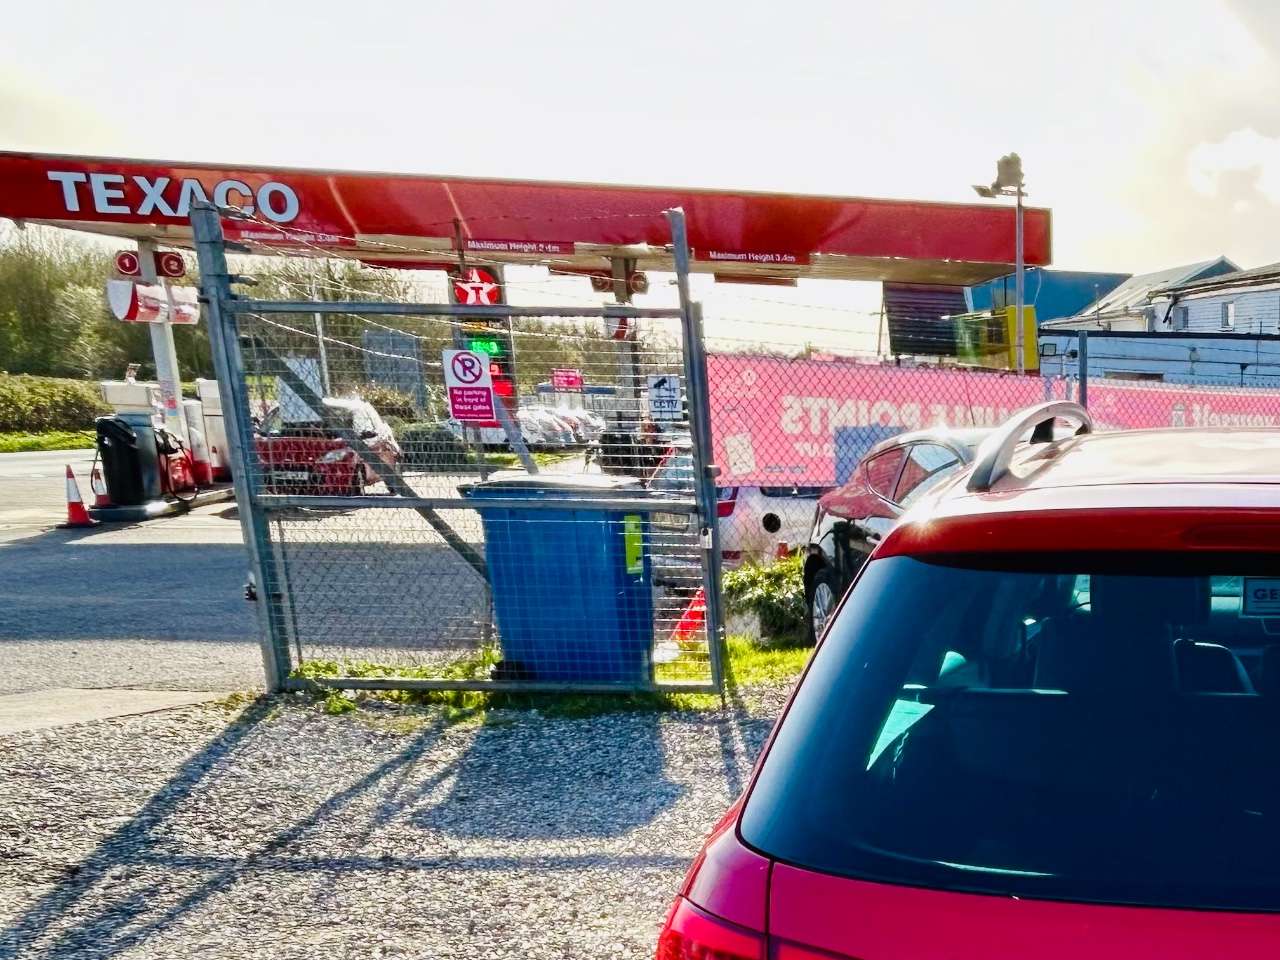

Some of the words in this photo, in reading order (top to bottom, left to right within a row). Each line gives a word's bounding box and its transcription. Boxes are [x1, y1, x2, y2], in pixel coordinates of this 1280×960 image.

[47, 170, 300, 223] TEXACO
[122, 257, 131, 269] 1
[168, 259, 179, 271] 2
[653, 400, 678, 409] CCTV
